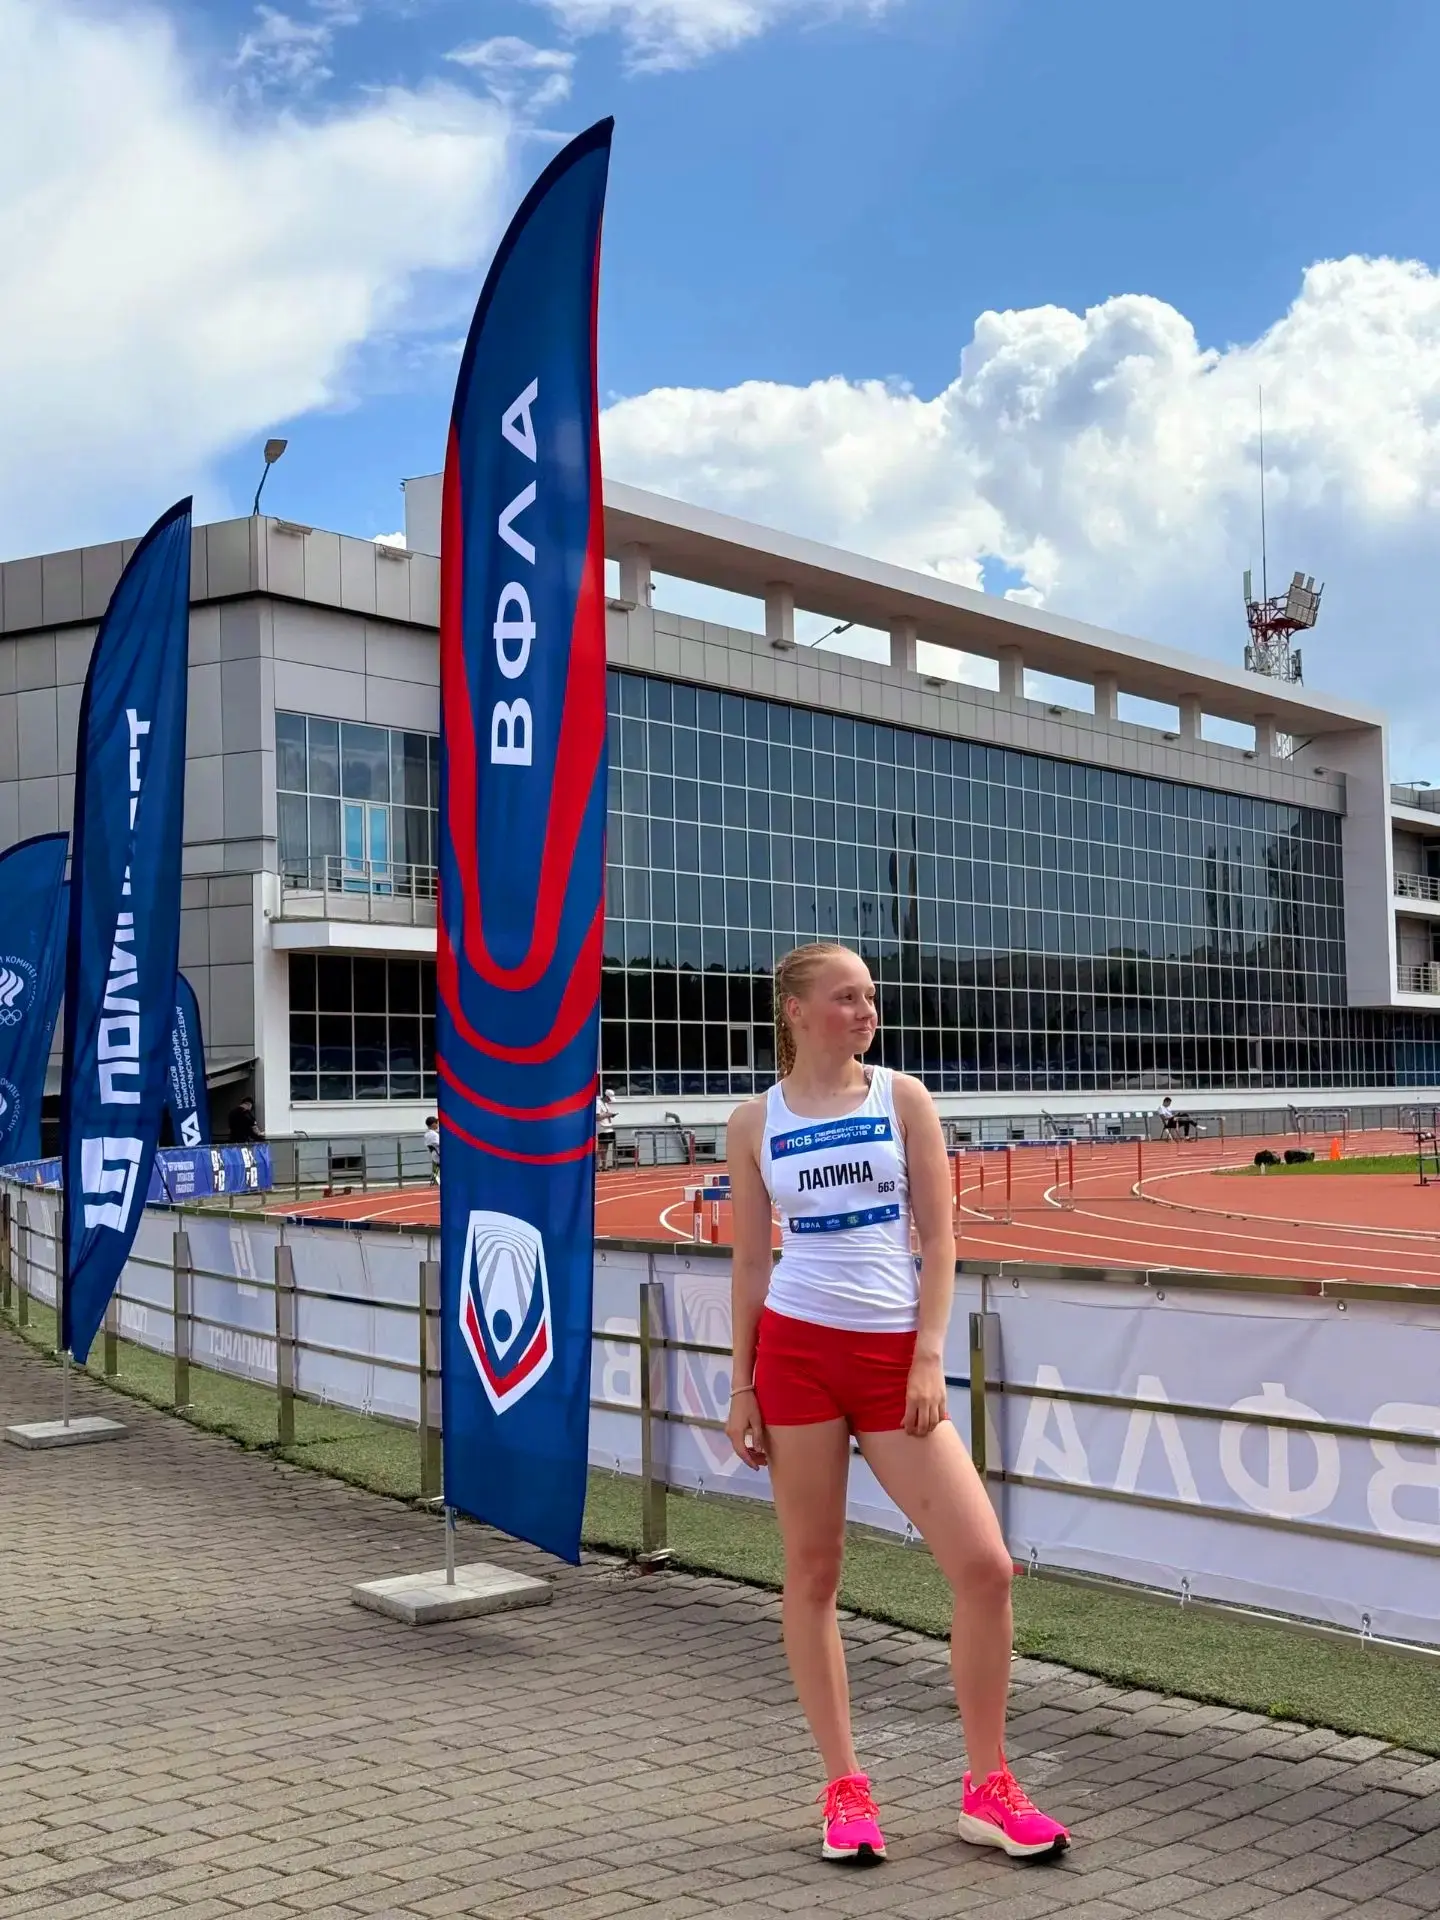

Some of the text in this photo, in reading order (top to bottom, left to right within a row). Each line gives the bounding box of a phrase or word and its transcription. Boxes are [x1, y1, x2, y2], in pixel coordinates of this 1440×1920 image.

[491, 376, 538, 766] ВФЛА
[5, 955, 37, 978] КОМИТЕТ
[814, 1124, 872, 1138] ПЕРВЕНСТВО
[814, 1132, 851, 1143] РОССИИ
[786, 1134, 812, 1149] ПСБ
[797, 1160, 874, 1192] ЛАПИНА
[877, 1180, 895, 1193] 563
